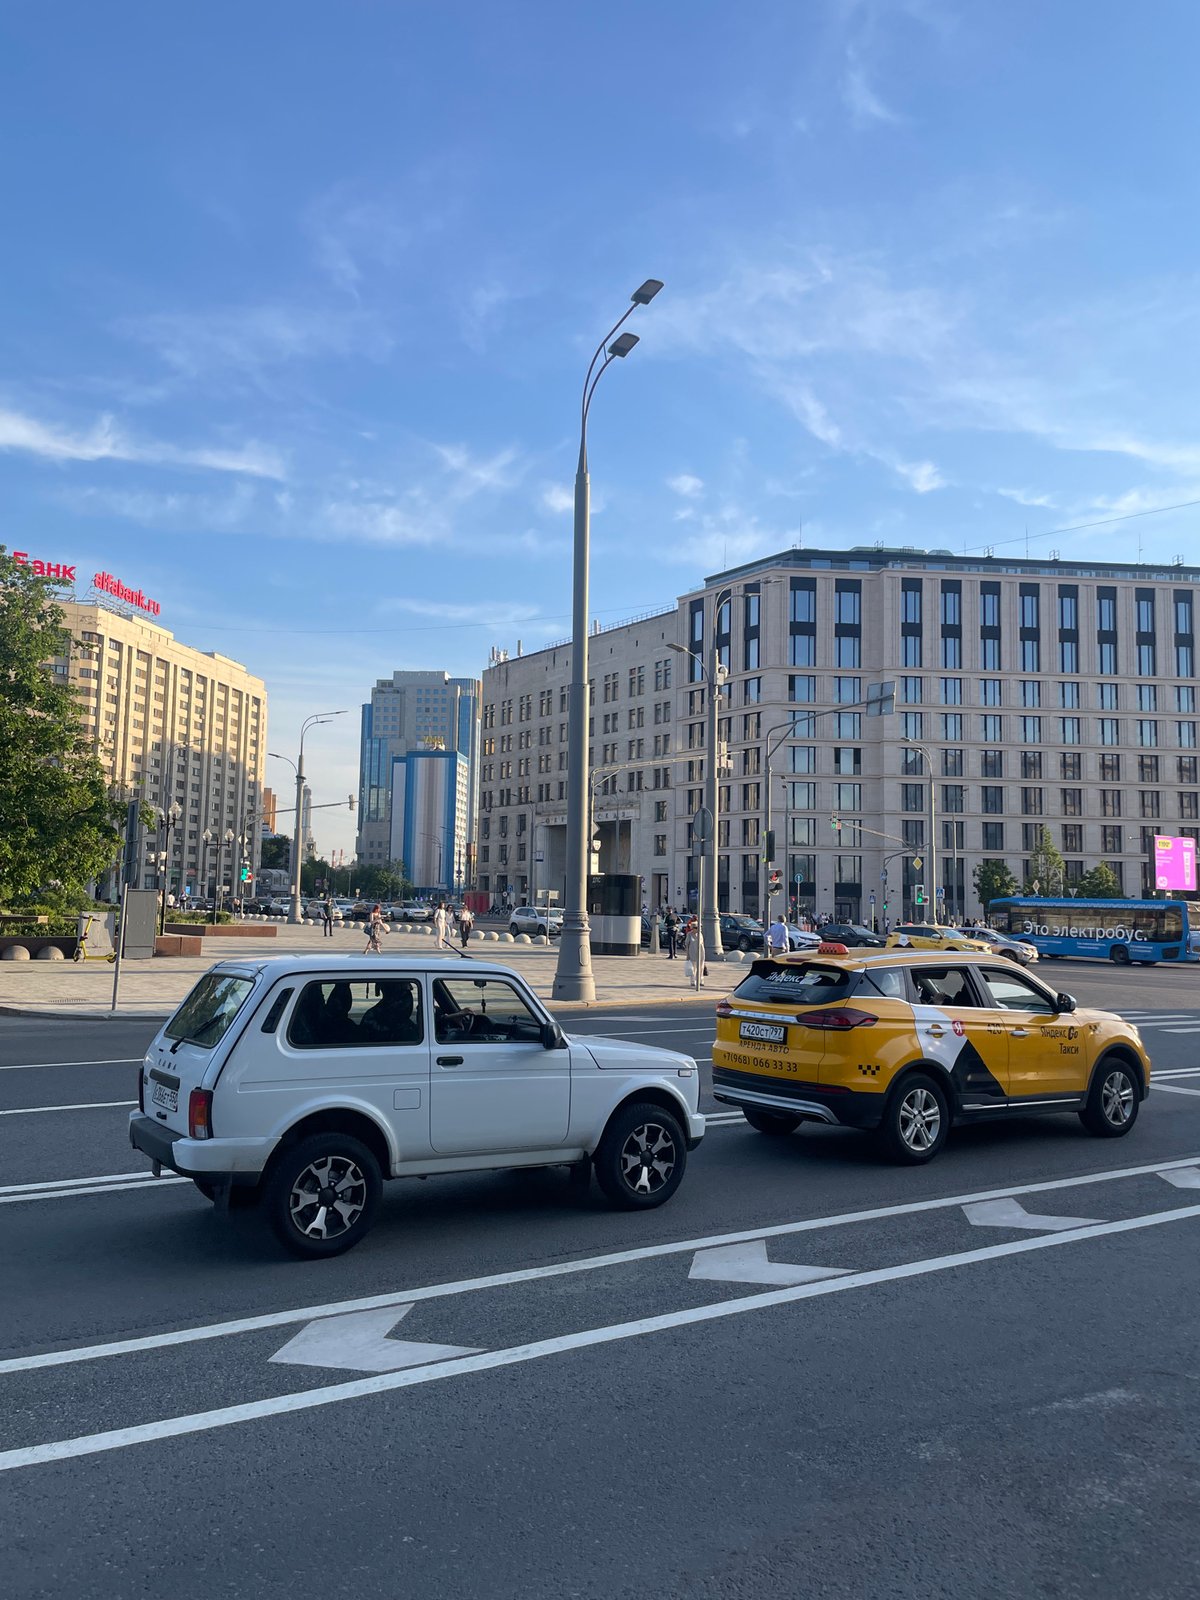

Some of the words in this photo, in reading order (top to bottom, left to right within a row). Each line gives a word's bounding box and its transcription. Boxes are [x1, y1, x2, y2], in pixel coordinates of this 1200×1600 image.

[94, 571, 160, 615] alfabank.ru
[1023, 920, 1049, 936] Это
[1052, 924, 1148, 944] электробус.
[1040, 1026, 1067, 1039] Яндекс
[1067, 1026, 1079, 1041] Go
[739, 1040, 766, 1051] АРЕНДА
[767, 1044, 790, 1055] АВТО
[1059, 1043, 1080, 1055] Такси
[752, 1057, 770, 1069] 066
[772, 1060, 784, 1071] 33
[786, 1062, 798, 1073] 33
